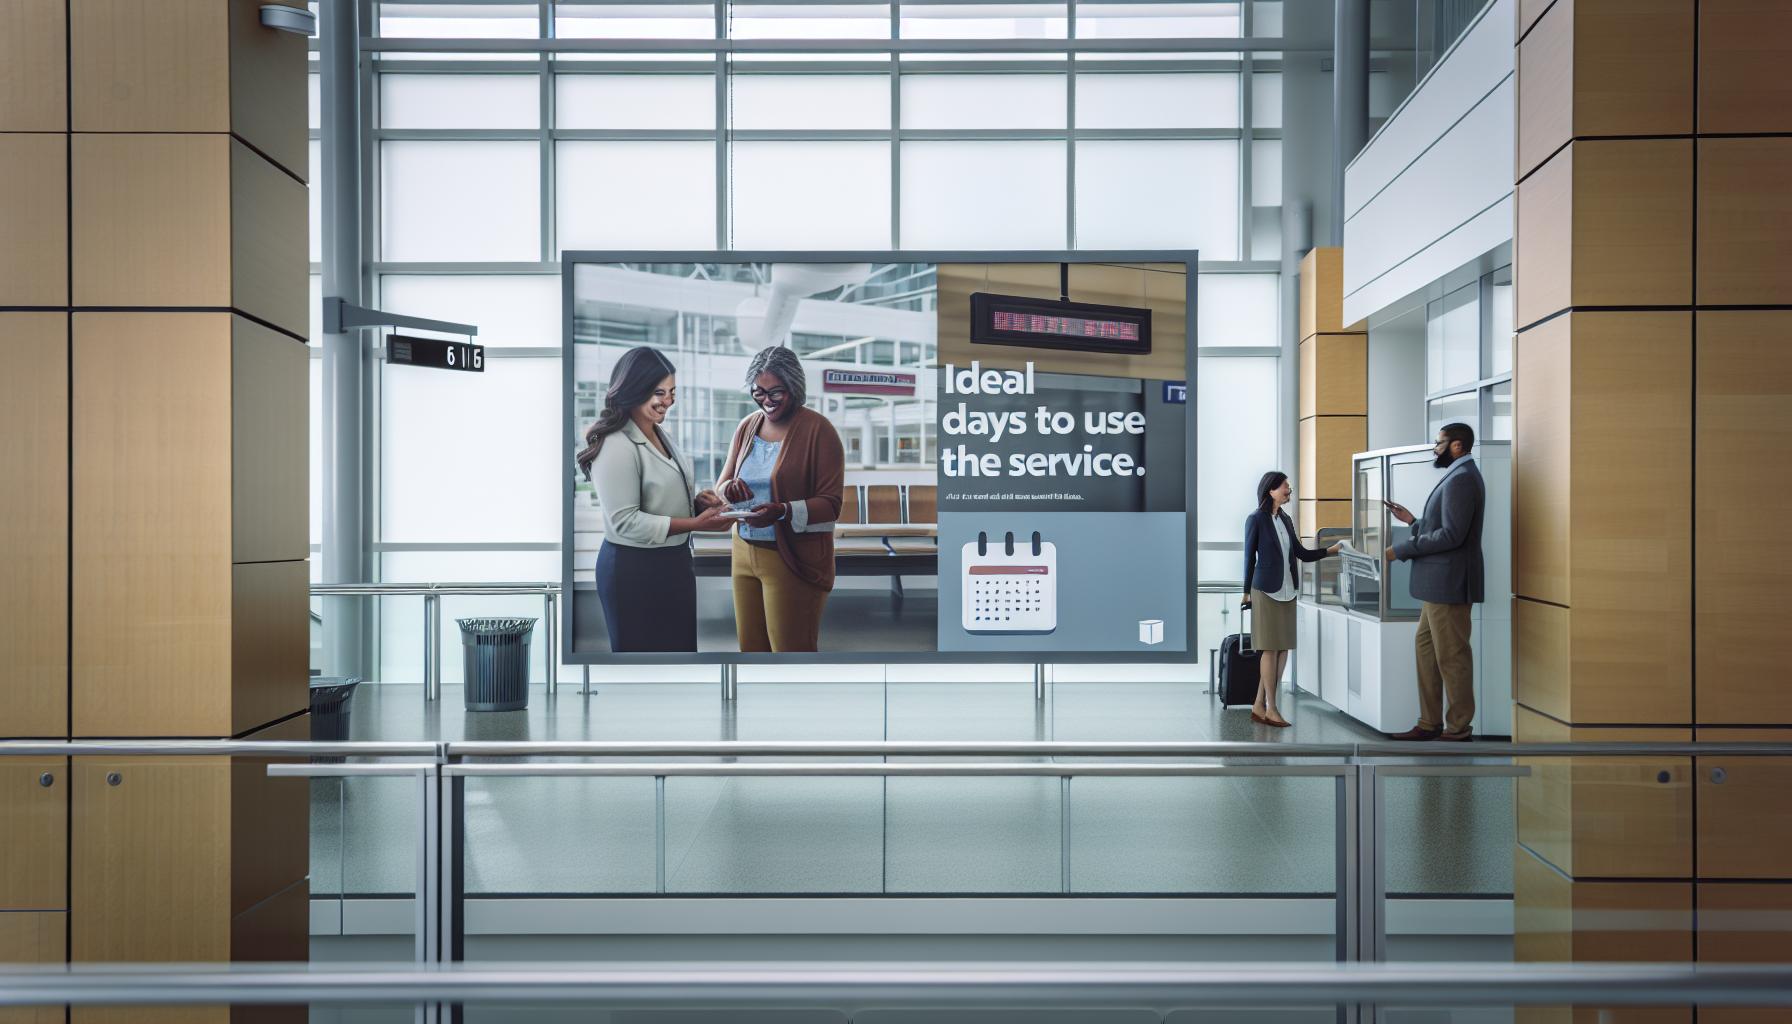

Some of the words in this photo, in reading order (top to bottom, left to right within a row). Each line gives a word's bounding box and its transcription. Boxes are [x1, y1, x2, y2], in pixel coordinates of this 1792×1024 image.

[945, 360, 1035, 395] Ideal
[942, 402, 1027, 443] days
[1035, 406, 1075, 435] to
[1084, 411, 1146, 435] use
[941, 444, 1002, 477] the
[1008, 444, 1146, 477] service.
